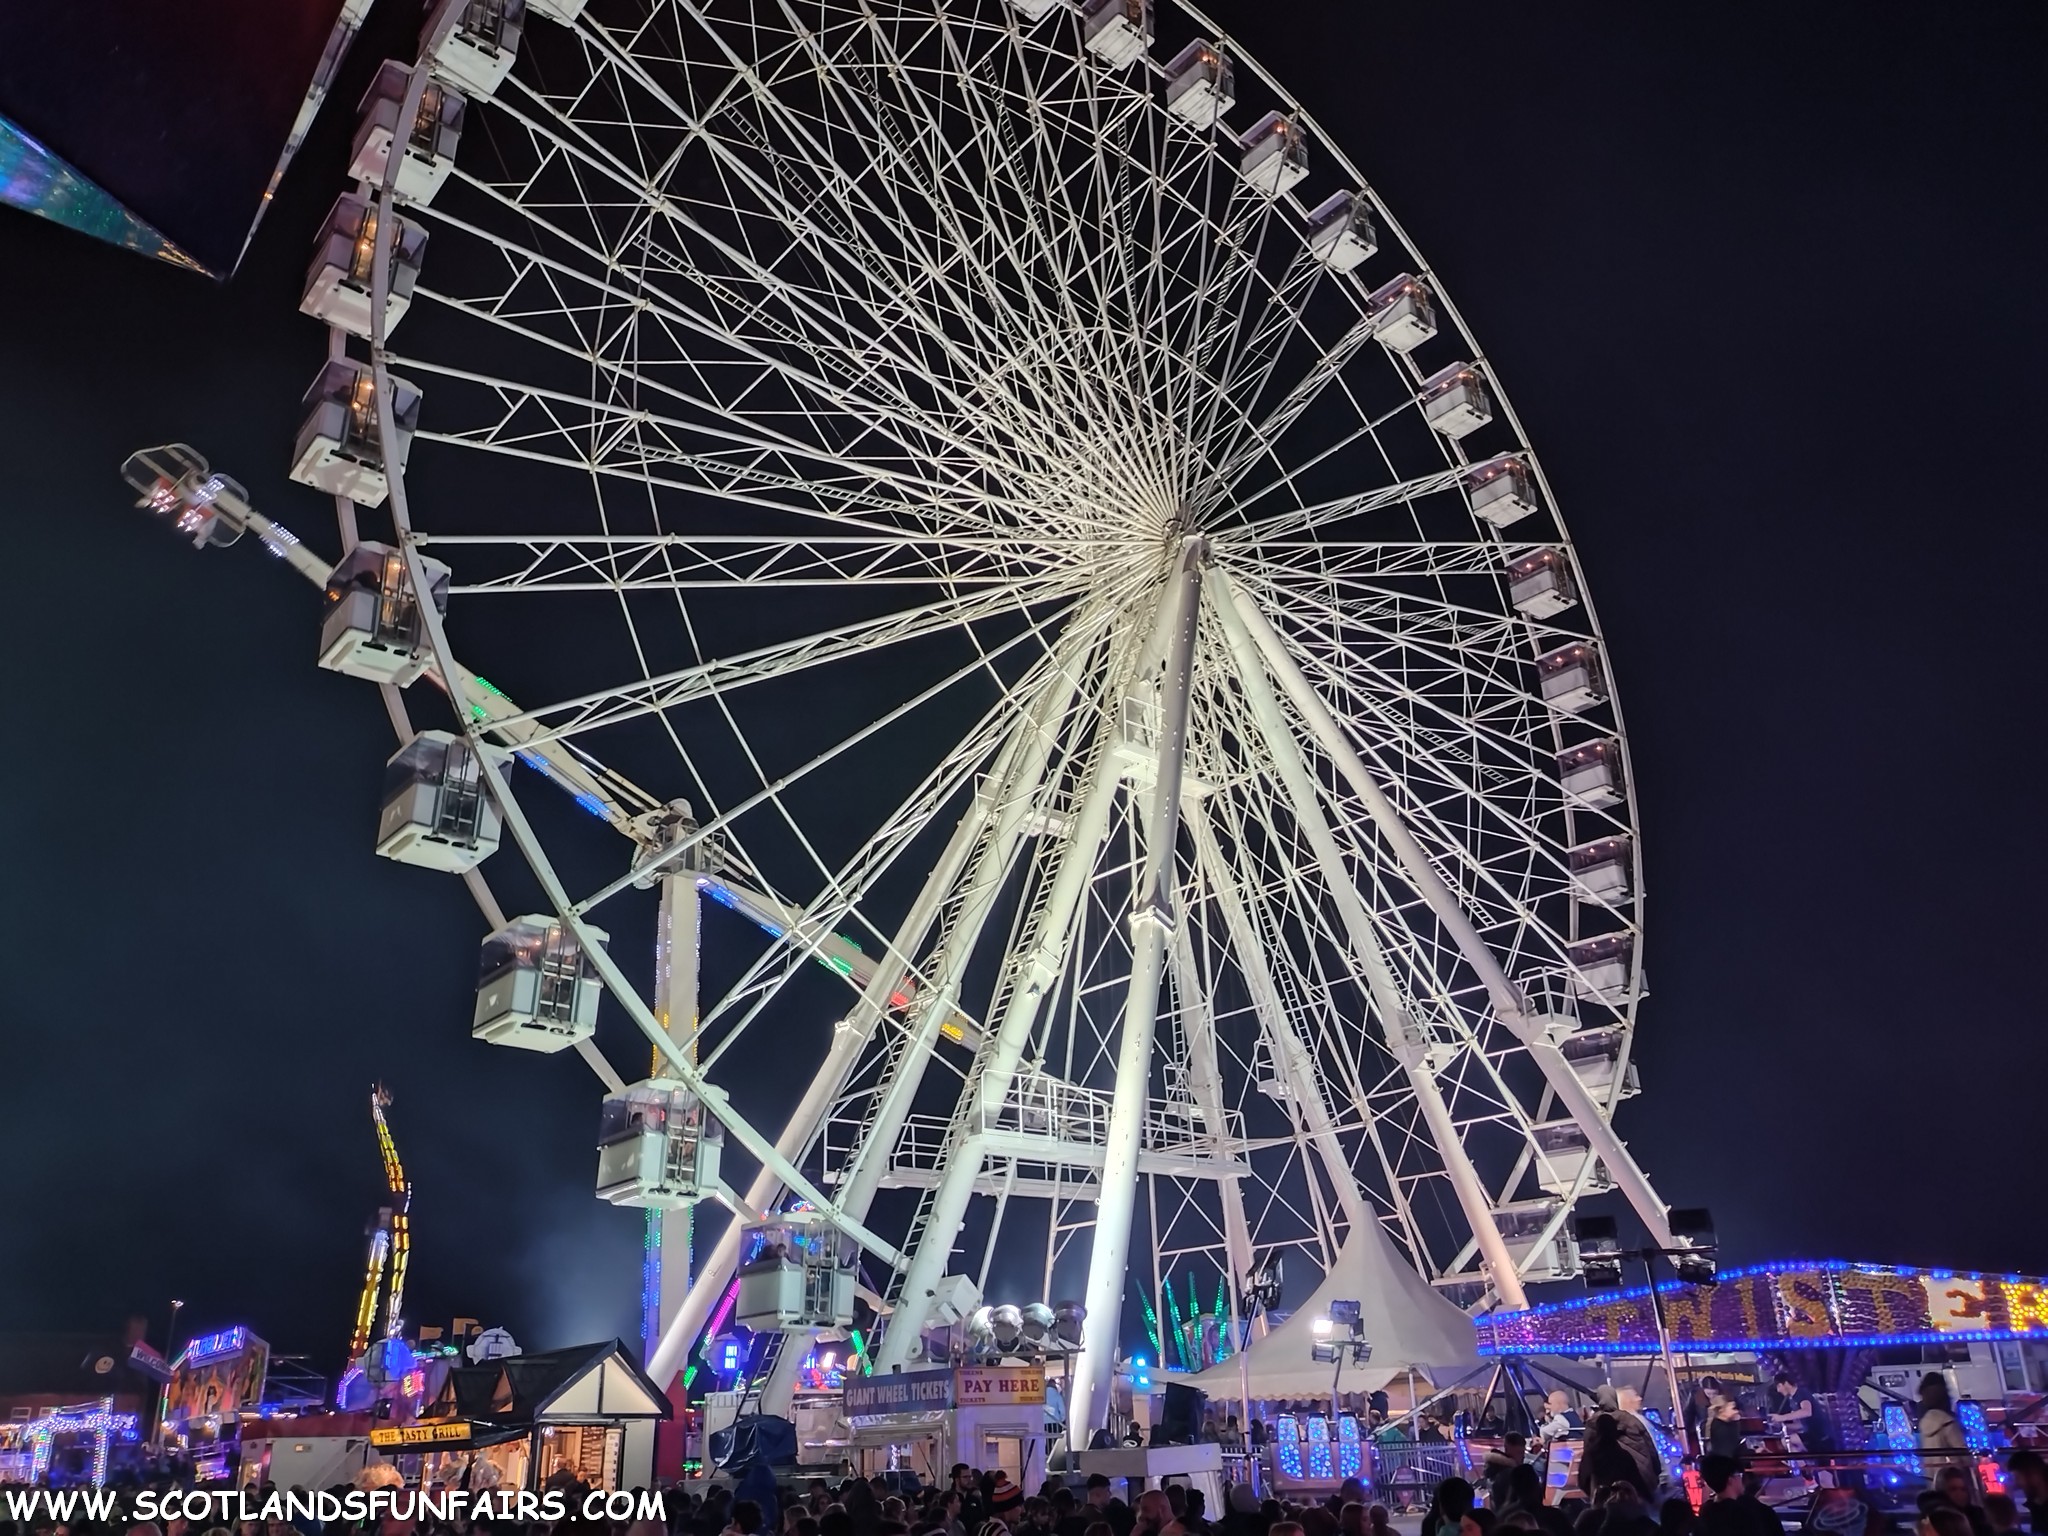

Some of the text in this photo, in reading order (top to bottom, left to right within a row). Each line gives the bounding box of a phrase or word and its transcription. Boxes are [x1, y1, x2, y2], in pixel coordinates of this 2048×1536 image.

[1585, 1271, 2048, 1343] TWISTER
[846, 1379, 950, 1407] GIANT WHEEL TICKETS
[964, 1379, 1040, 1393] PAY HERE
[379, 1426, 461, 1443] THE TASTY GRILL
